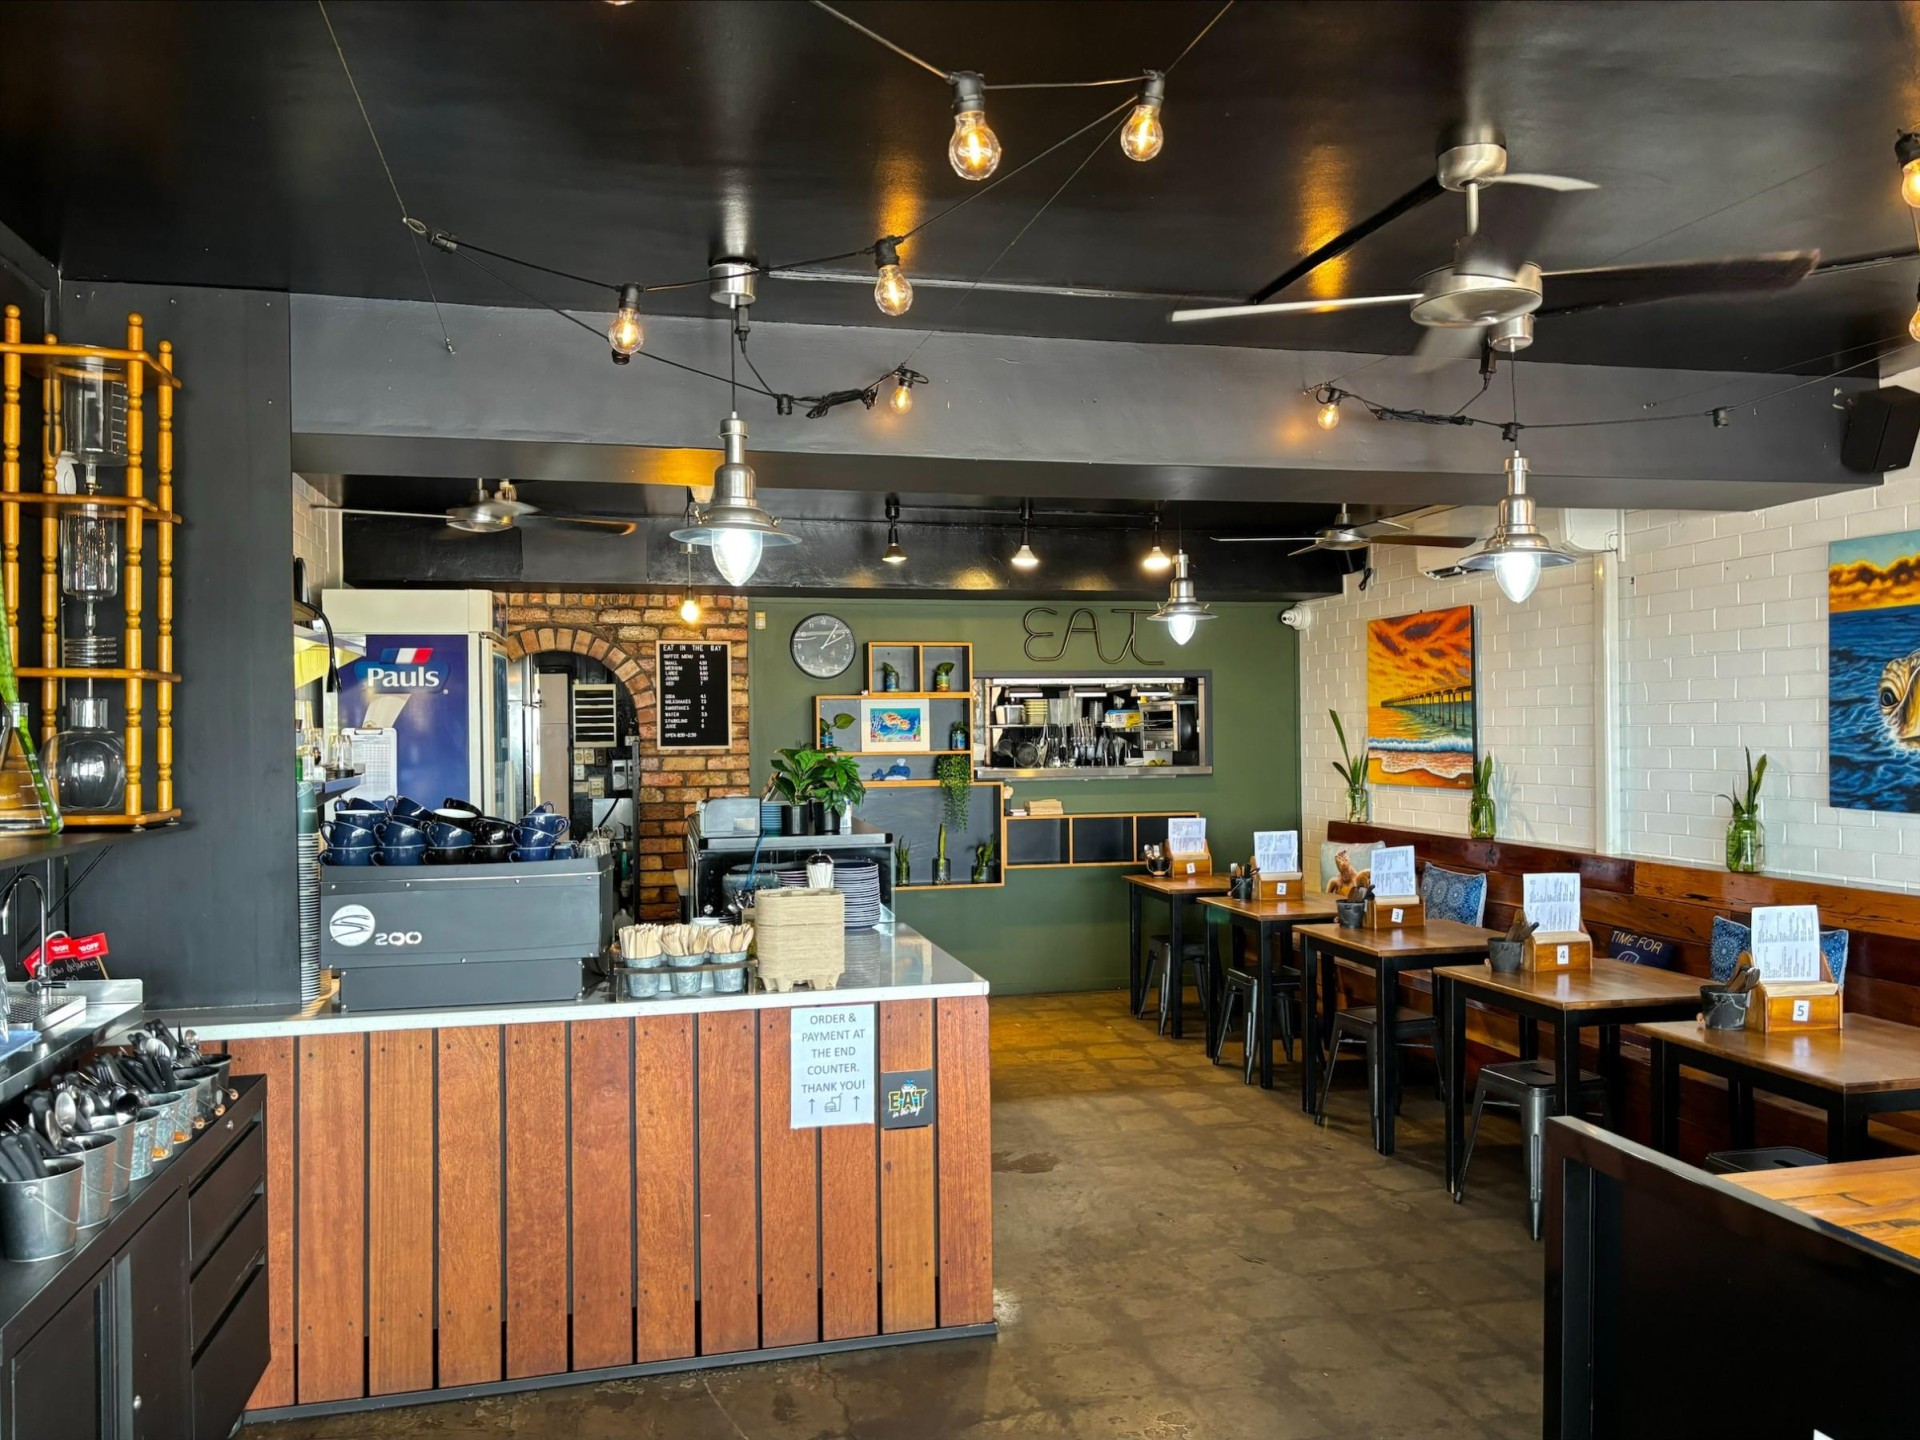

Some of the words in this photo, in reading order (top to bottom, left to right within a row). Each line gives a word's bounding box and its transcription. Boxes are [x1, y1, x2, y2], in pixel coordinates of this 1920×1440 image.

[1023, 607, 1166, 666] EAT
[662, 644, 675, 652] EAT
[679, 644, 686, 652] IN
[691, 644, 704, 652] THE
[710, 644, 722, 652] BAY
[367, 666, 440, 688] Pauls
[1278, 885, 1285, 893] 2
[1393, 911, 1400, 920] 3
[374, 931, 423, 946] 200
[1610, 930, 1638, 947] TIME
[1636, 936, 1663, 955] FOR
[1559, 950, 1566, 960] 4
[1796, 1005, 1805, 1017] 5
[810, 1013, 846, 1025] ORDER
[848, 1012, 857, 1023] &
[801, 1030, 851, 1043] PAYMENT
[852, 1029, 866, 1039] AT
[811, 1048, 832, 1059] THE
[834, 1046, 856, 1057] END
[807, 1063, 860, 1076] COUNTER.
[801, 1082, 838, 1094] THANK
[840, 1079, 866, 1091] YOU!
[888, 1088, 929, 1112] EAT
